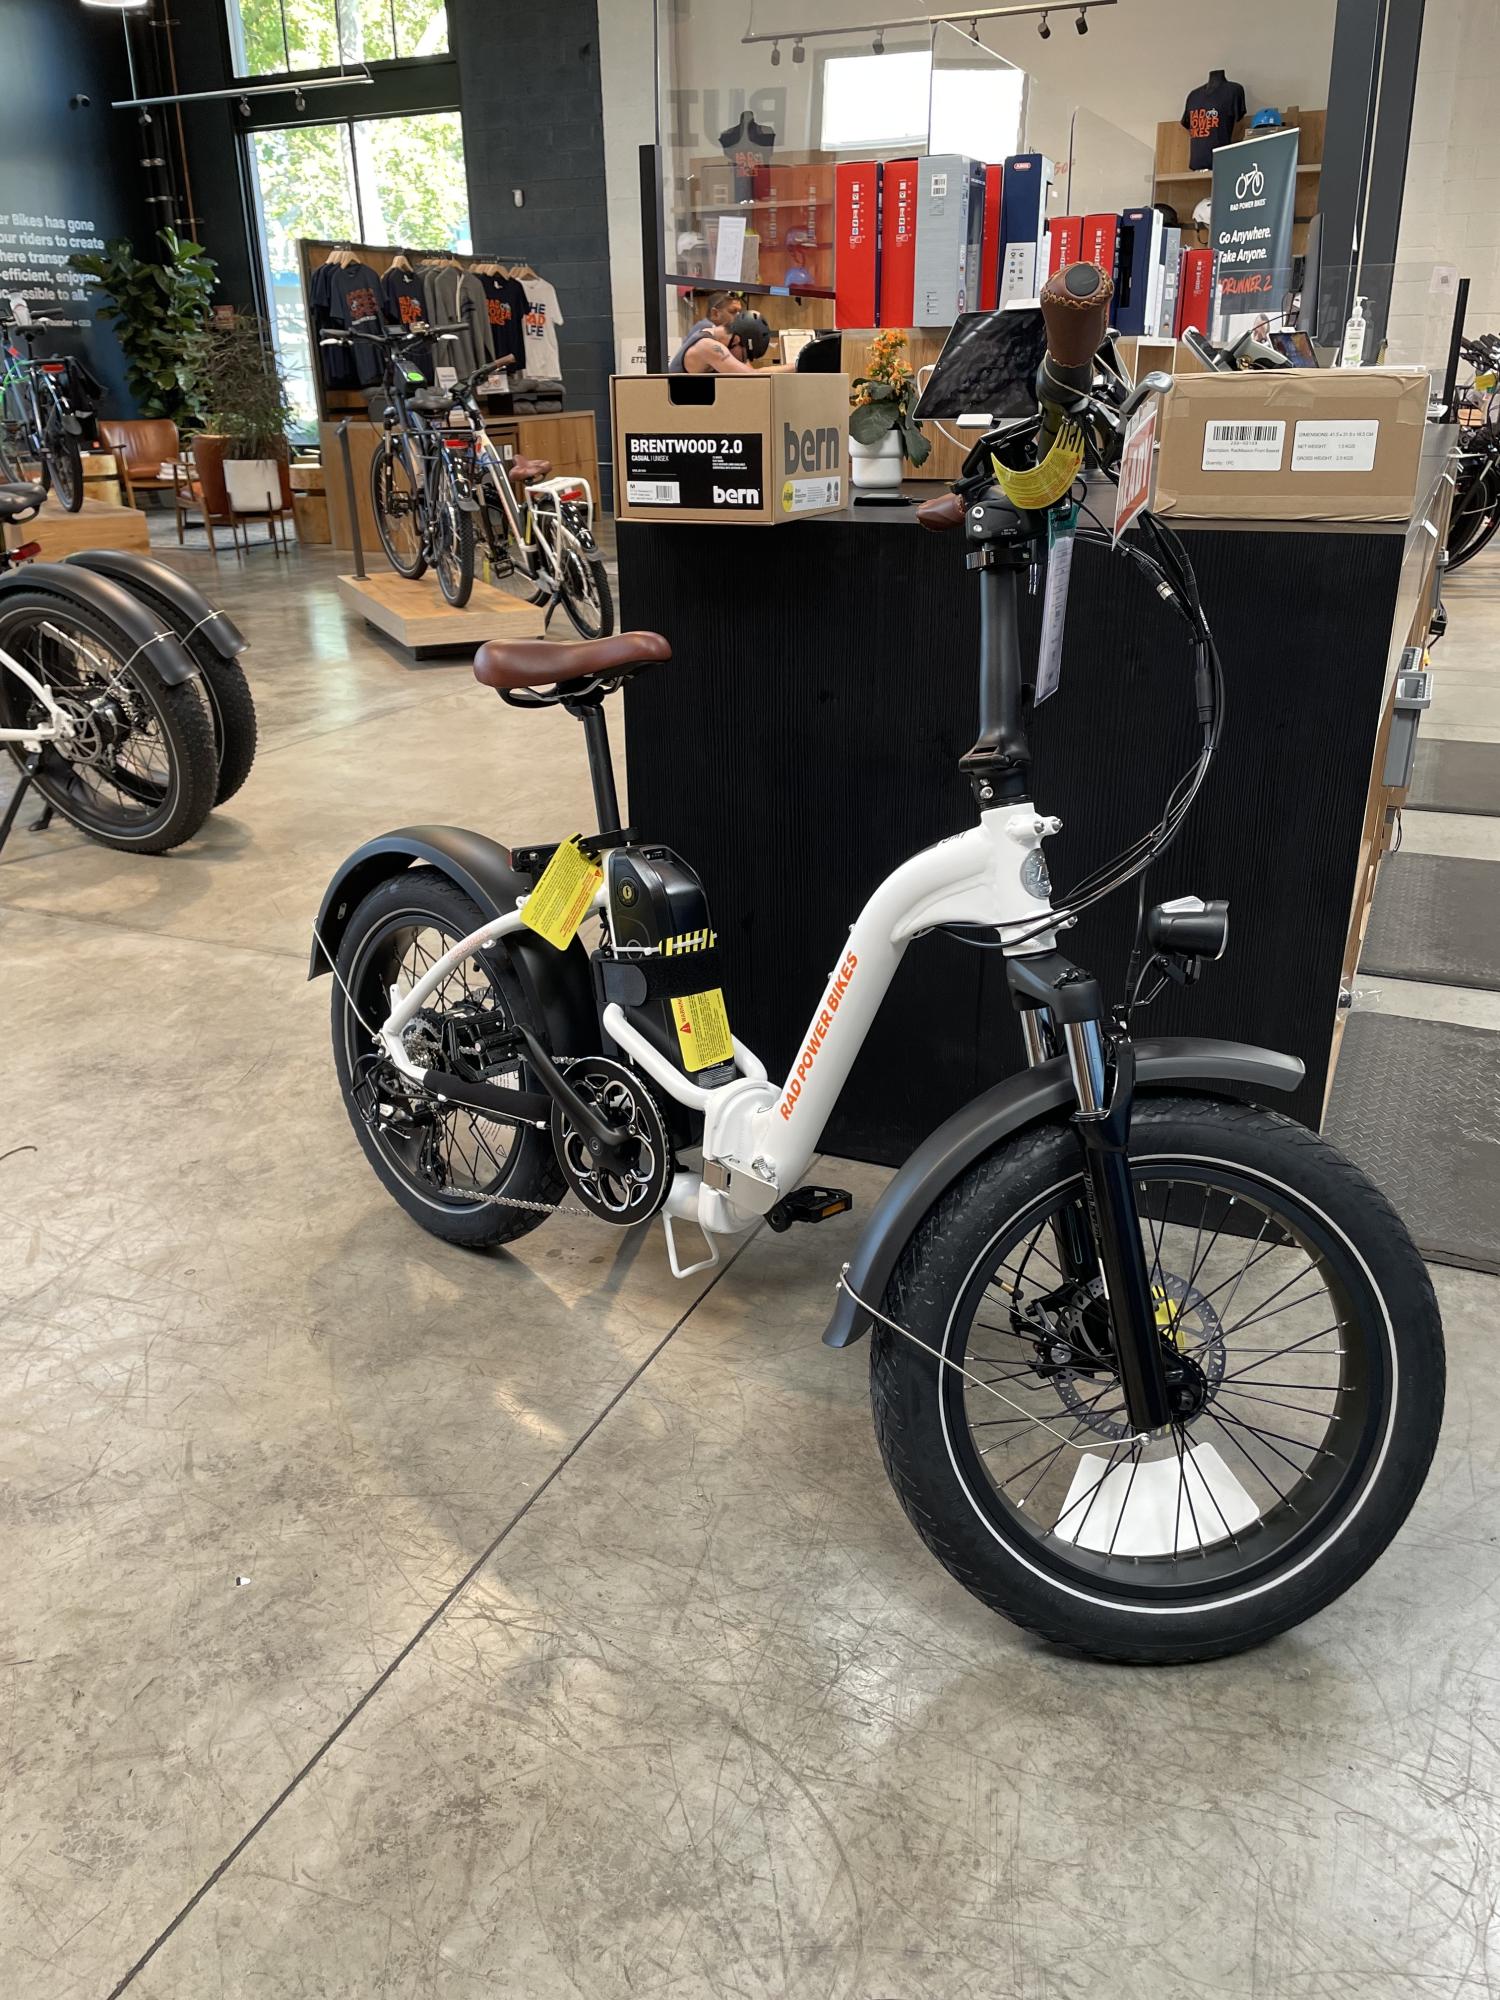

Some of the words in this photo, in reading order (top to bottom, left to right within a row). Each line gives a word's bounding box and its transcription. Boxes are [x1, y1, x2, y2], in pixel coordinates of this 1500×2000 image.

[1229, 203, 1239, 212] RAD
[1239, 200, 1255, 210] POWER
[1253, 197, 1268, 207] BIKES
[11, 213, 44, 228] Bikes
[44, 215, 66, 230] has
[67, 219, 95, 234] gone
[19, 231, 54, 247] riders
[55, 235, 68, 247] to
[69, 238, 105, 250] create
[1218, 231, 1231, 245] Go
[1230, 226, 1272, 245] Anywhere.
[1219, 249, 1237, 264] Take
[1236, 247, 1268, 265] Anyone.
[1263, 275, 1273, 292] 2
[57, 288, 70, 301] to
[630, 439, 717, 453] BRENTWOOD
[720, 439, 743, 454] 2.0
[783, 422, 840, 475] bern
[712, 485, 760, 505] bern
[779, 1078, 803, 1121] RAD
[796, 1009, 834, 1082] POWER
[826, 949, 860, 1013] BIKES
